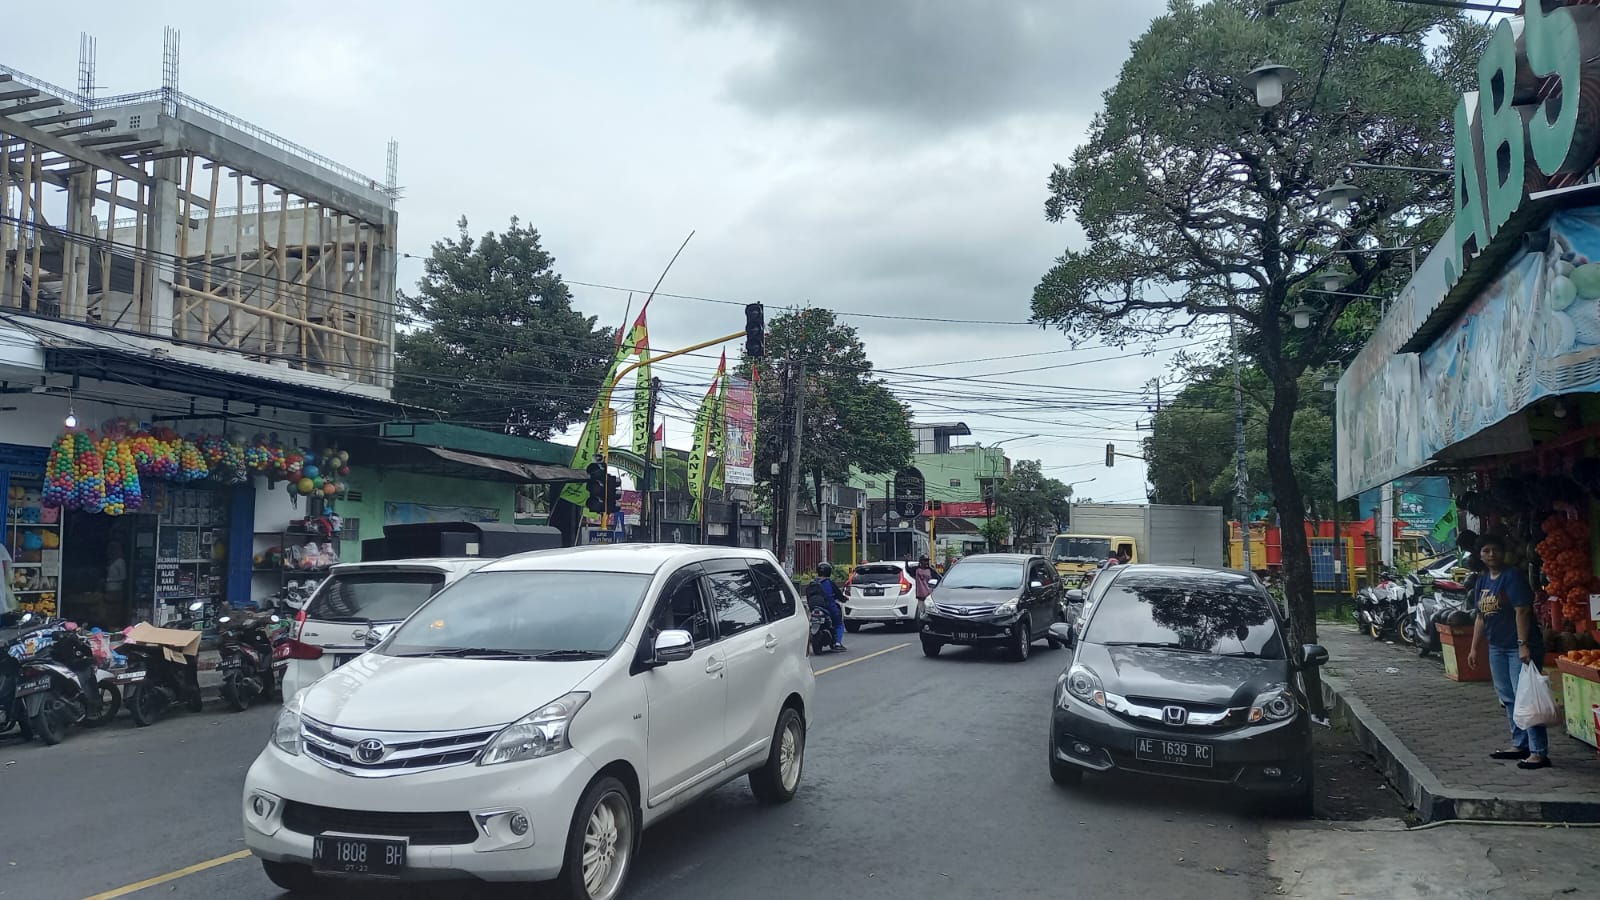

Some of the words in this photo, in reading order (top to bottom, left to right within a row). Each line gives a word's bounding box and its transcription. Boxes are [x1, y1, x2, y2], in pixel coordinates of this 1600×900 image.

[1140, 740, 1153, 752] AE
[1162, 742, 1187, 757] 1639
[1195, 745, 1209, 759] RC
[315, 839, 323, 858] N
[337, 841, 367, 862] 1808
[385, 845, 403, 865] BH
